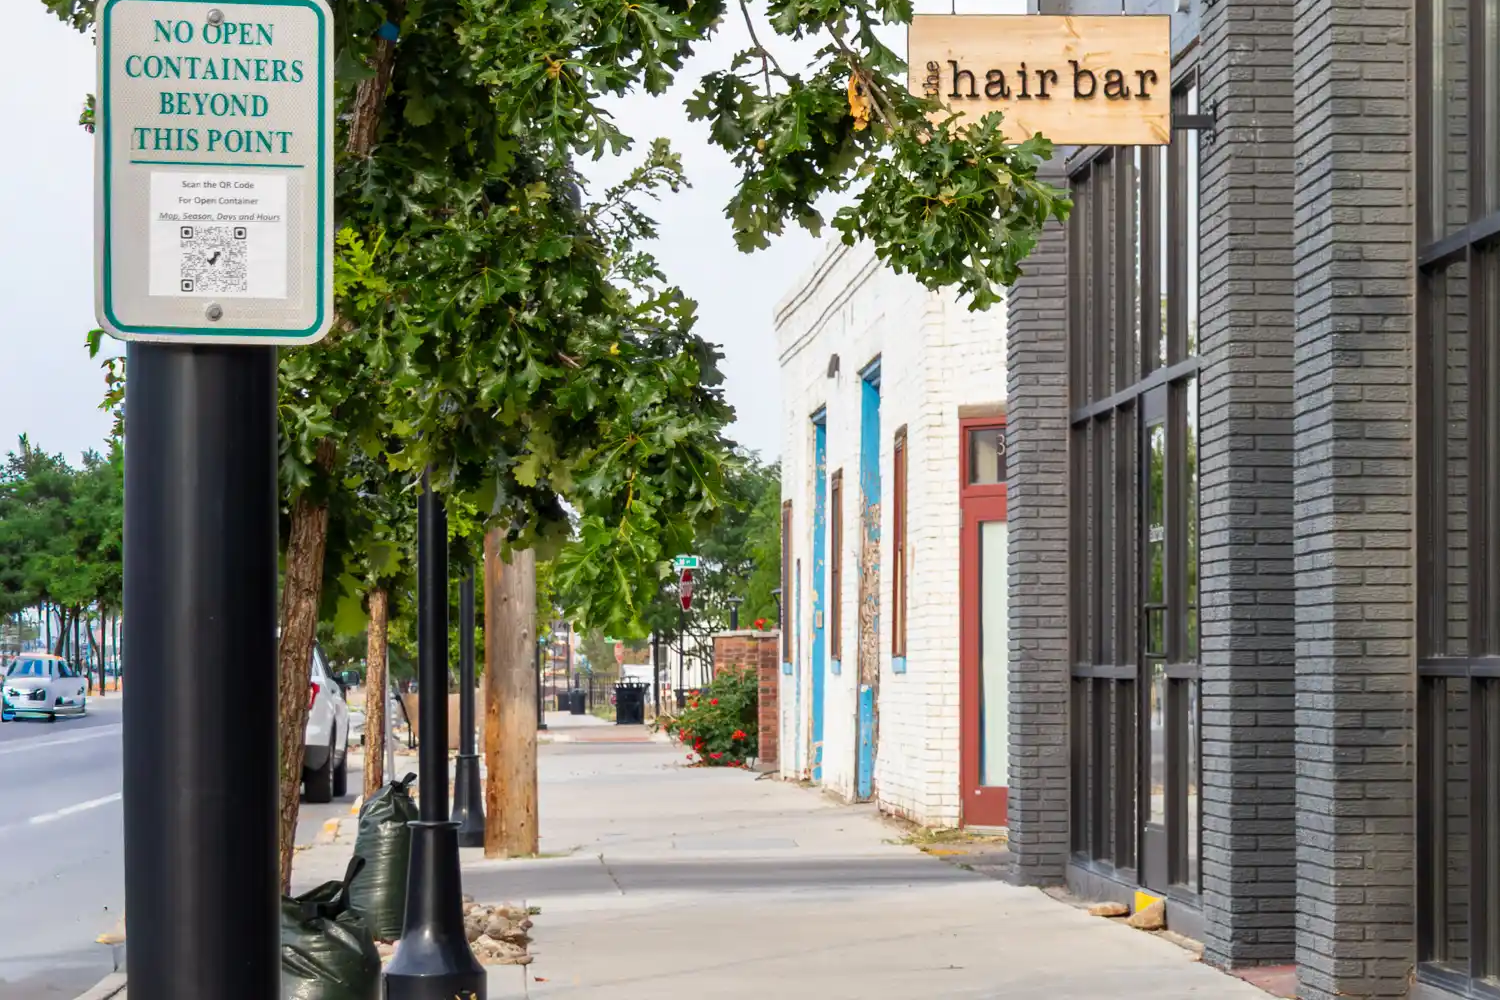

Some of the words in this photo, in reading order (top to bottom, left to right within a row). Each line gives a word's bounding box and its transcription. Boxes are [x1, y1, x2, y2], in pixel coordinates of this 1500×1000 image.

[153, 19, 194, 44] NO
[202, 21, 275, 47] OPEN
[125, 54, 305, 83] CONTAINERS
[922, 60, 941, 98] the
[947, 60, 1058, 100] hair
[1068, 60, 1159, 100] bar
[159, 92, 269, 117] BEYOND
[134, 127, 199, 152] THIS
[206, 129, 293, 154] POINT
[182, 180, 201, 188] Scan
[203, 181, 217, 189] the
[219, 181, 232, 189] QR
[234, 181, 255, 189] Code
[194, 197, 217, 205] Open
[218, 197, 259, 205] Container
[217, 213, 237, 221] Days
[239, 213, 255, 221] and
[256, 213, 281, 221] Hours
